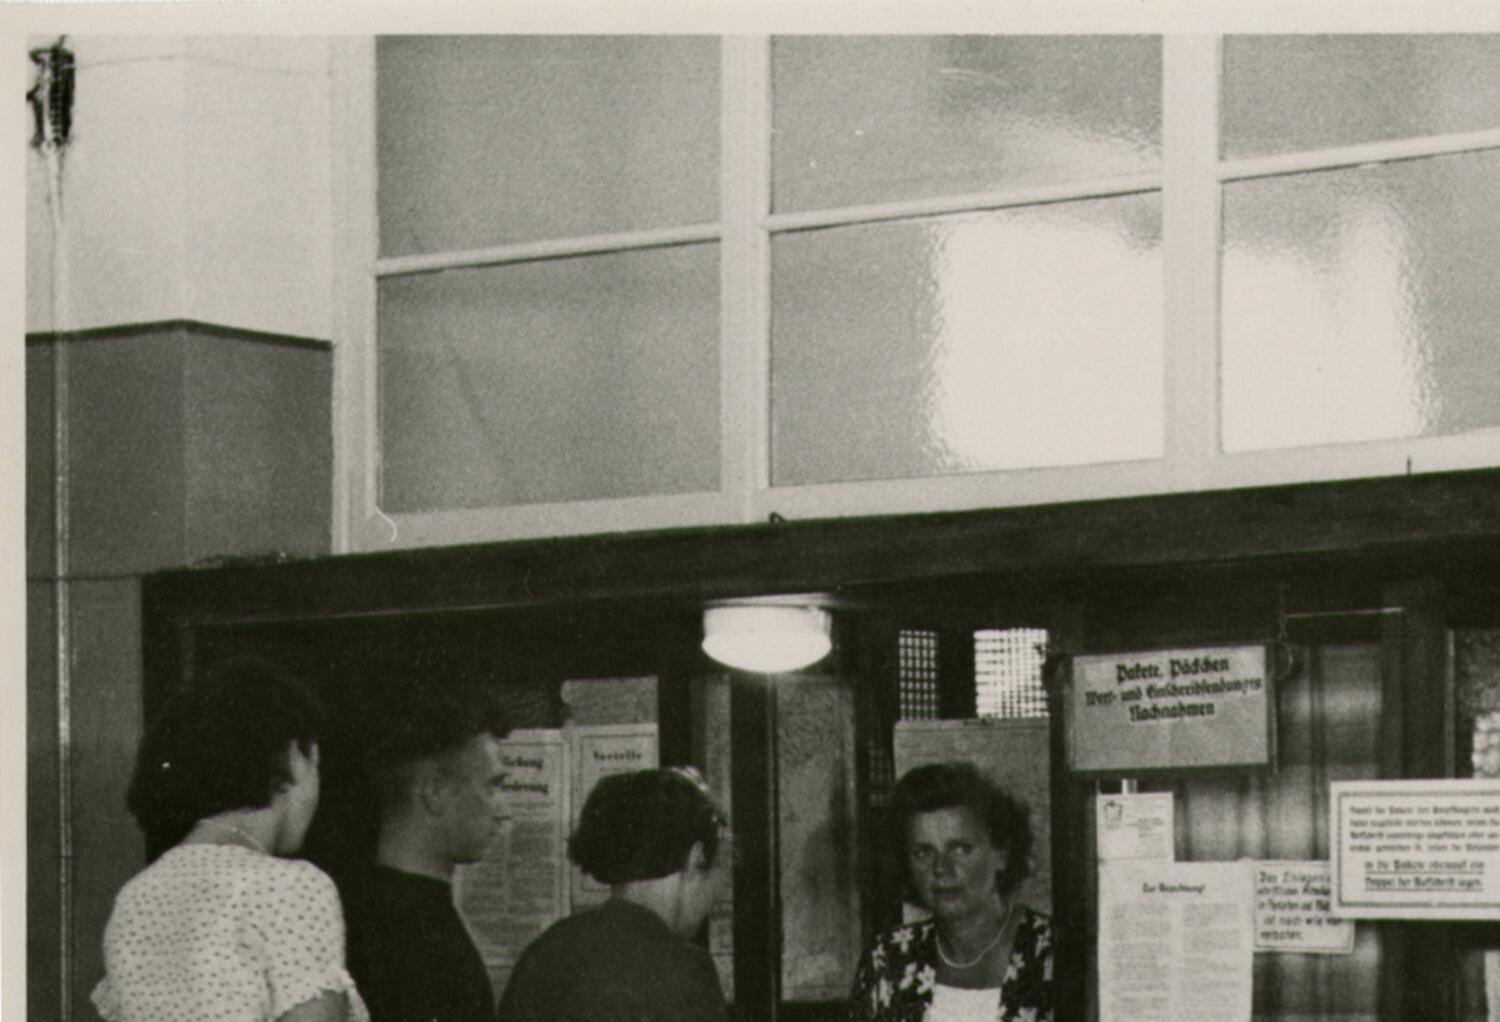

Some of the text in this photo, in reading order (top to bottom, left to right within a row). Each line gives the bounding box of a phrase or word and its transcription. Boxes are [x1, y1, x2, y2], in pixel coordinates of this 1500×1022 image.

[1116, 657, 1229, 683] Pakete, Päckchen
[1121, 687, 1142, 702] und
[1129, 701, 1215, 722] Nachnahmen
